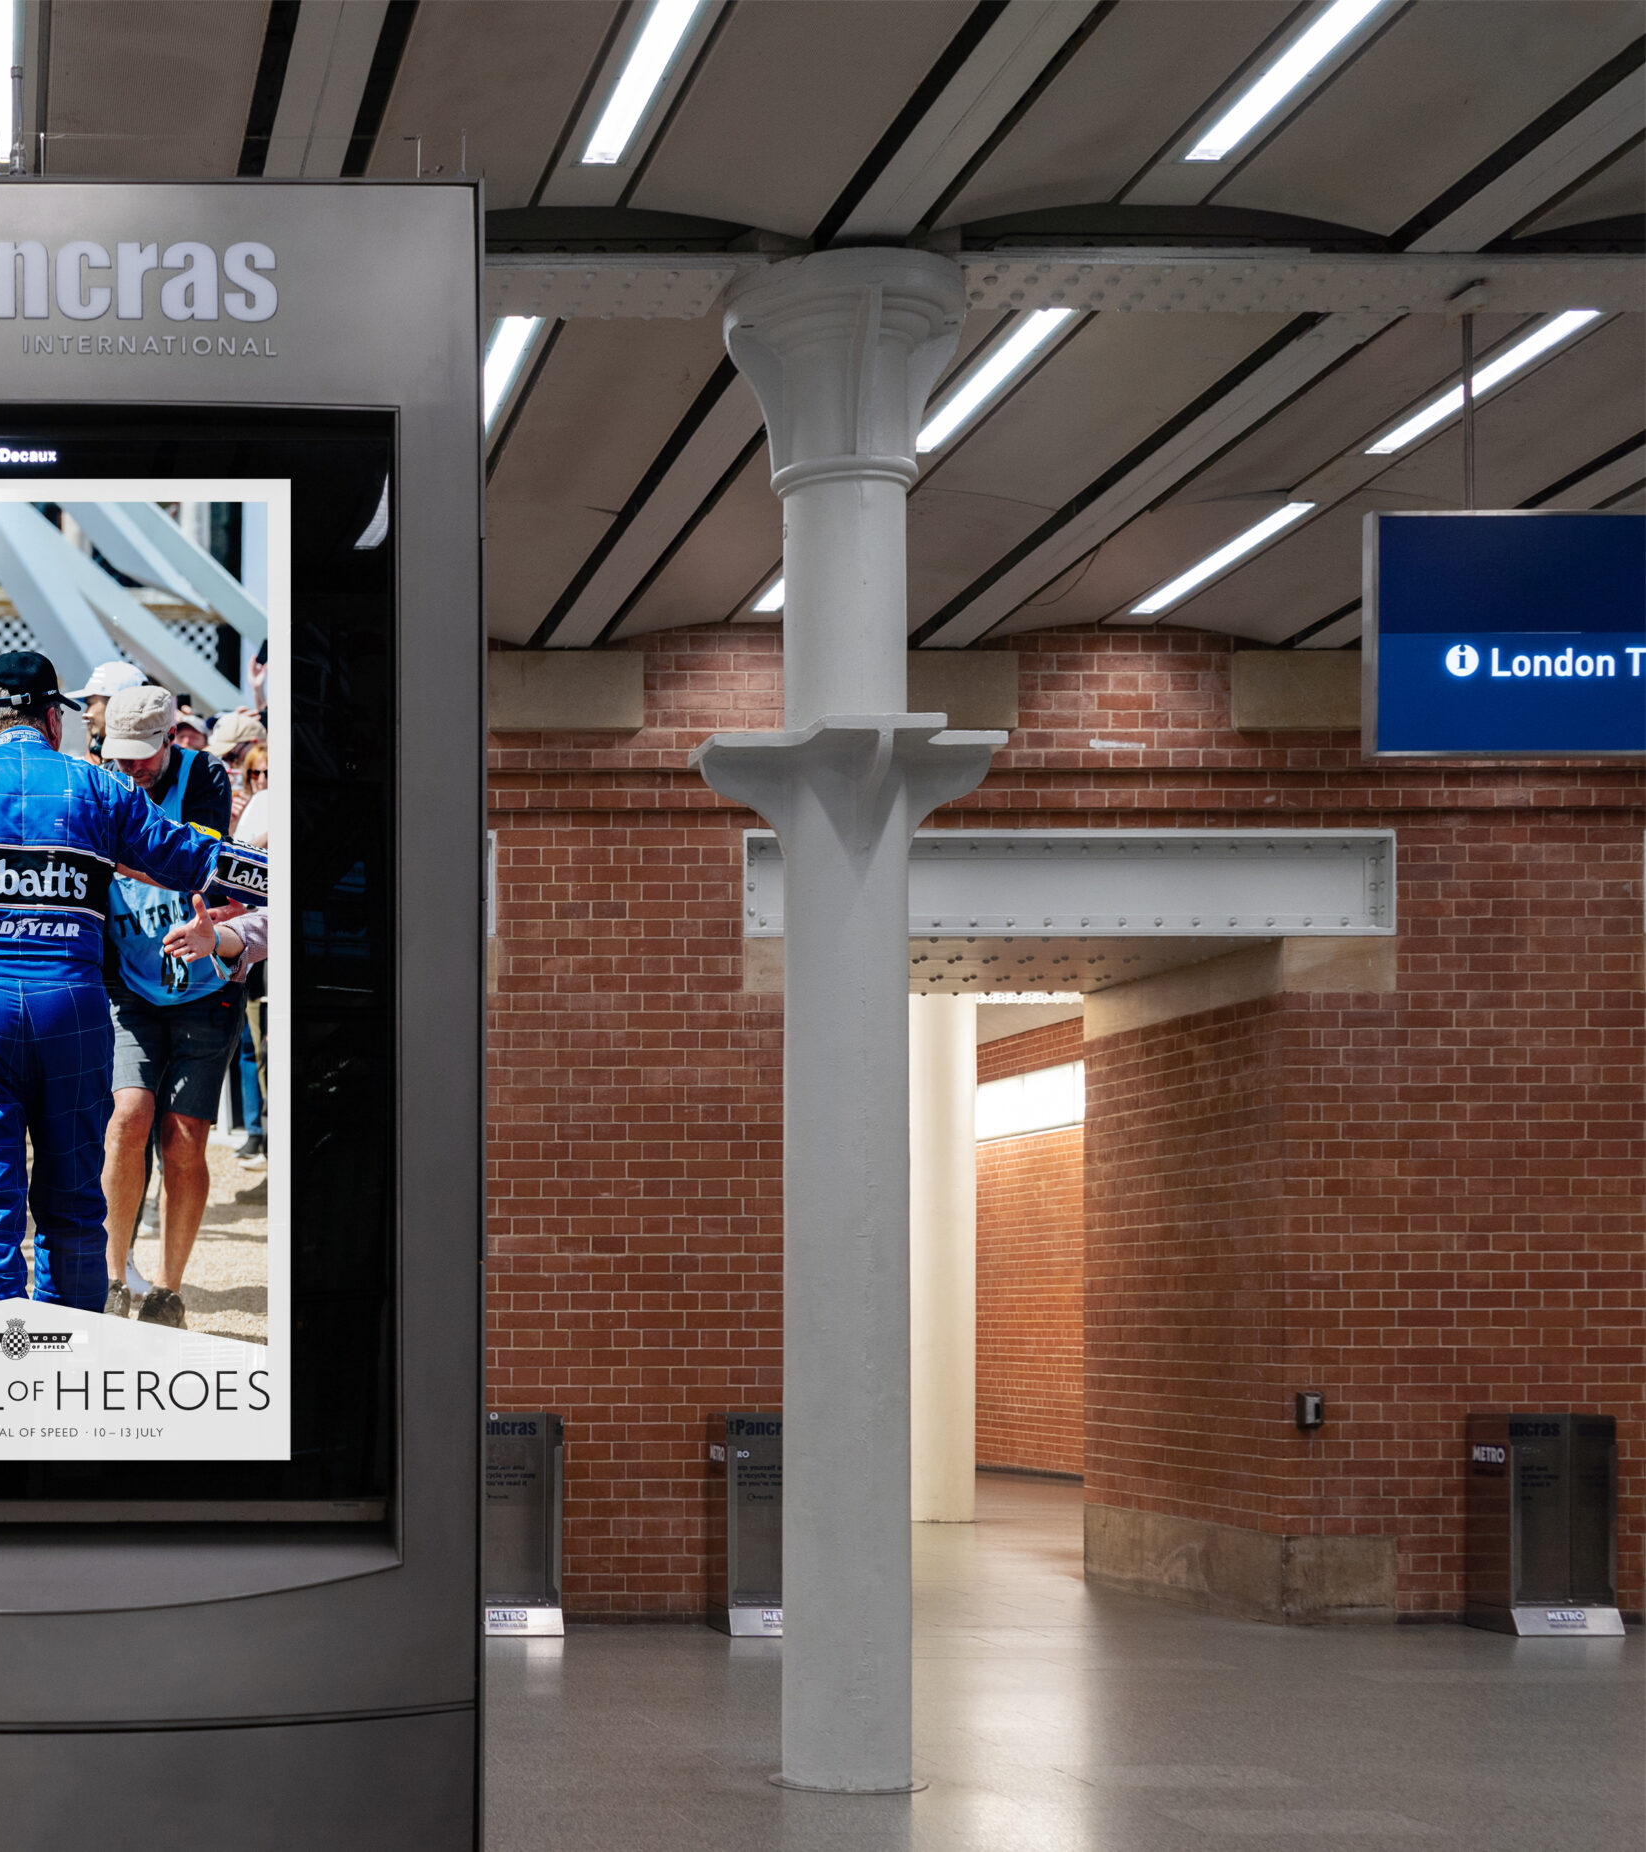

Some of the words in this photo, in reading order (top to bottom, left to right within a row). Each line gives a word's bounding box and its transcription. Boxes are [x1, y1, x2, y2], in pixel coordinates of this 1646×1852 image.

[22, 335, 278, 358] INTERNATIONAL
[1491, 648, 1616, 677] London
[114, 911, 141, 938] TV
[7, 1380, 45, 1402] OF
[57, 1370, 271, 1411] HEROES
[19, 1427, 36, 1438] OF
[41, 1427, 79, 1438] SPEED
[135, 1427, 164, 1440] JULY
[727, 1419, 783, 1436] tPancr
[1472, 1445, 1505, 1464] METRO
[489, 1611, 527, 1621] METRO
[1547, 1610, 1585, 1621] METRO
